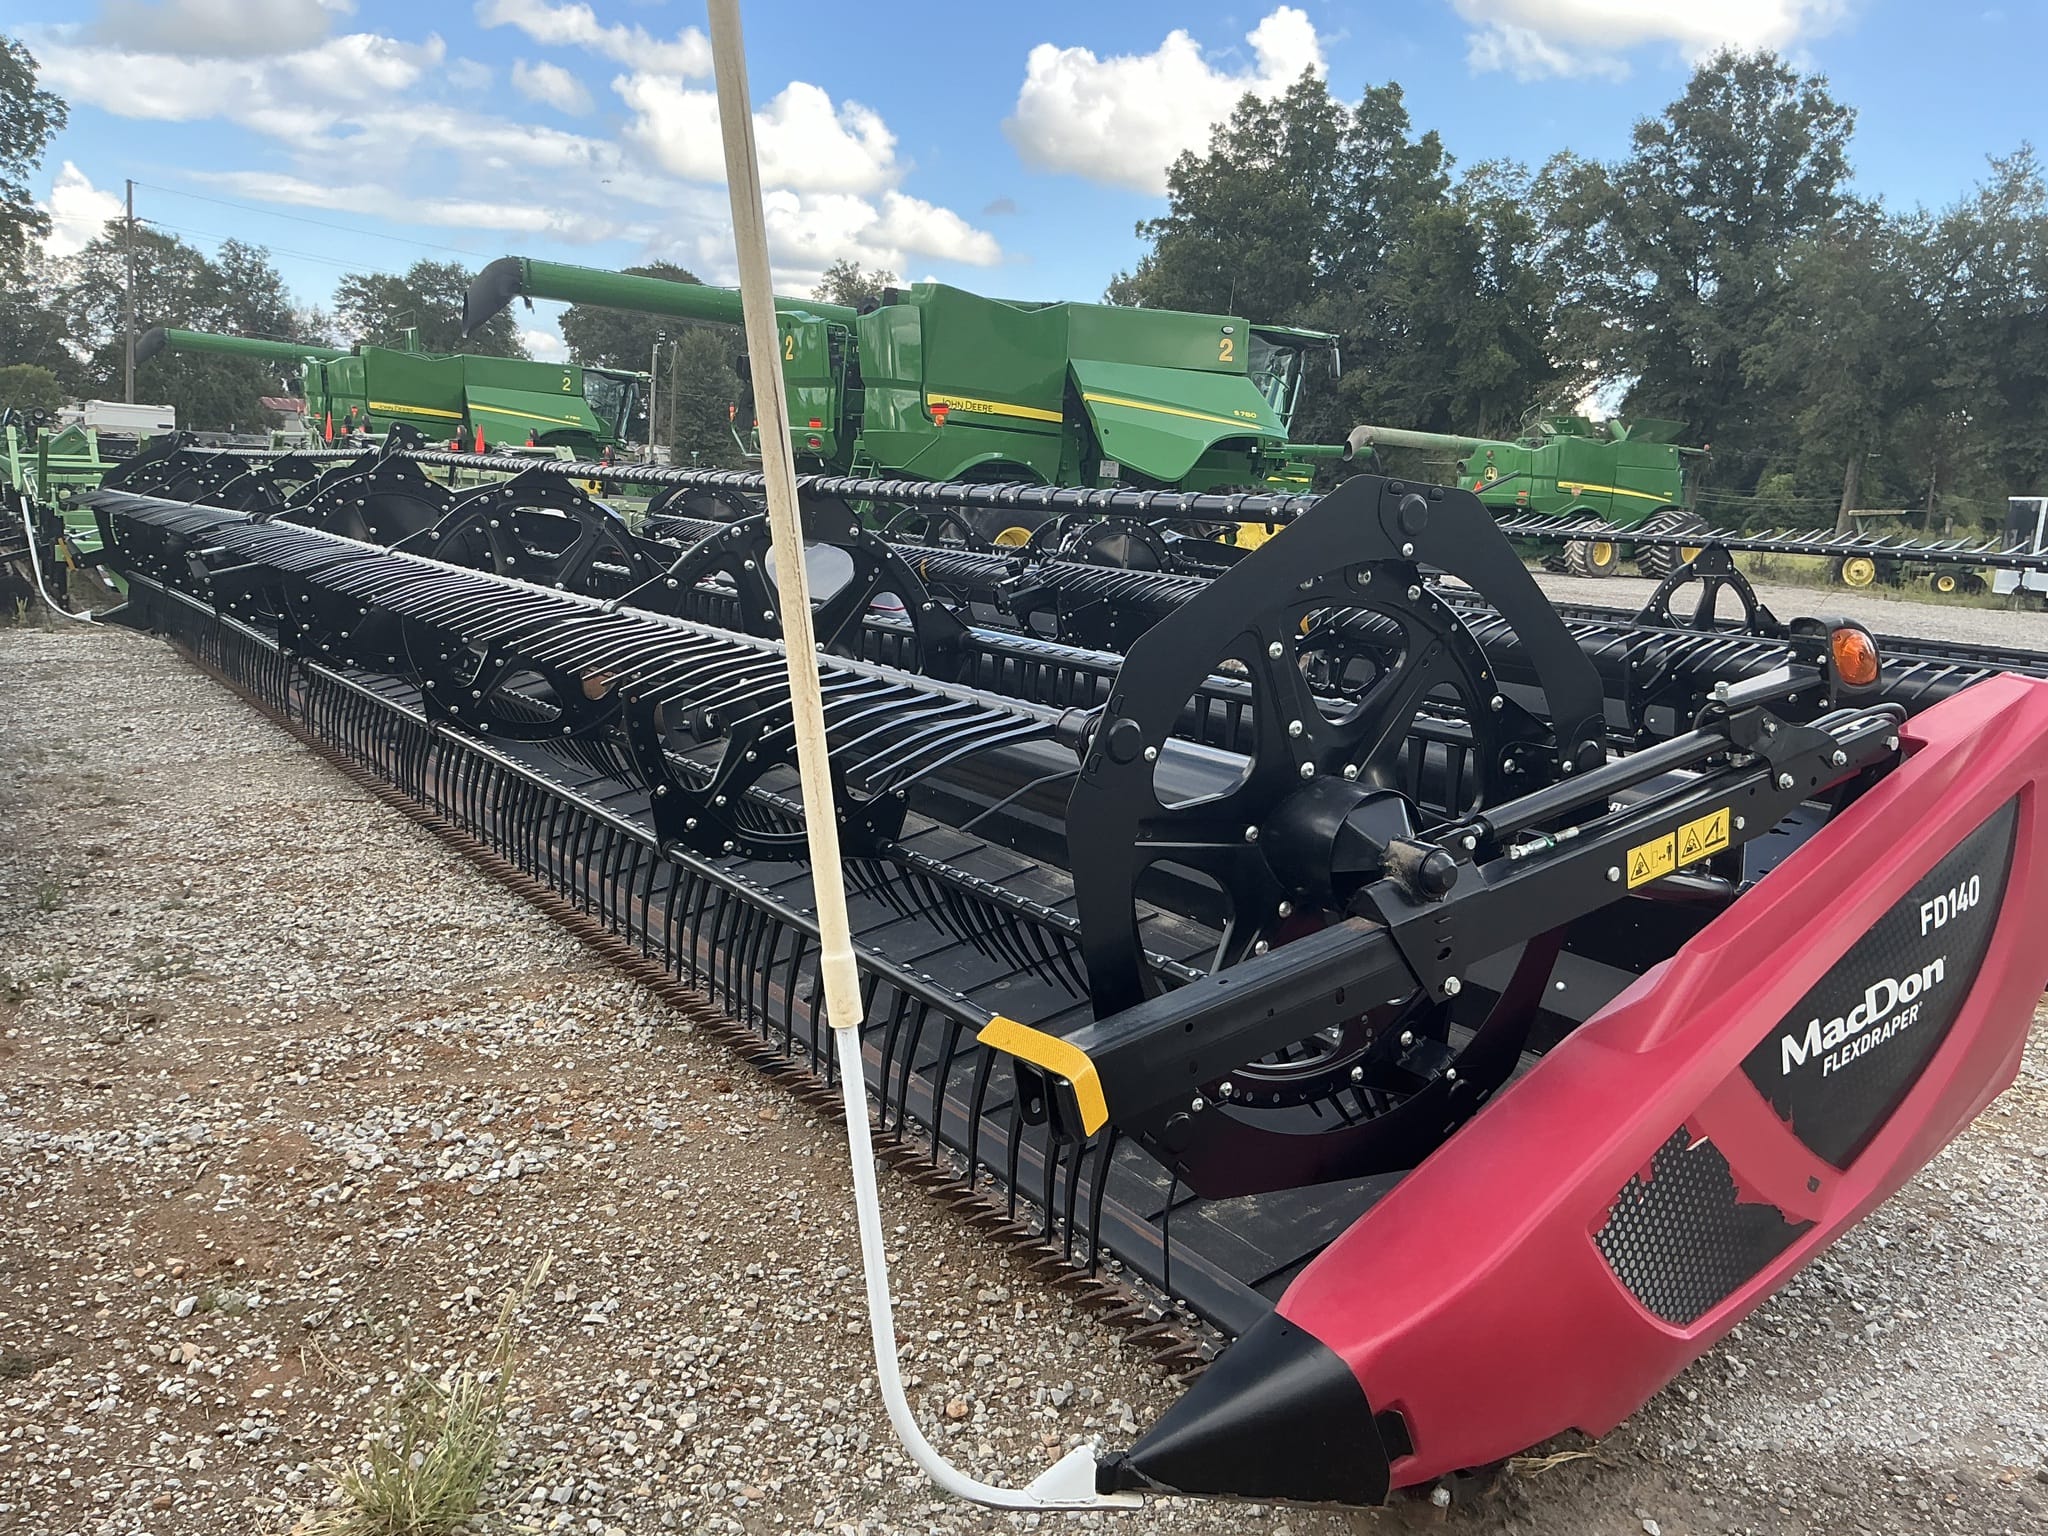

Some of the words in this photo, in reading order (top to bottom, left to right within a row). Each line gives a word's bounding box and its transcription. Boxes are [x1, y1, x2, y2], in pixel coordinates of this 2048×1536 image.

[785, 335, 794, 360] 2
[1218, 338, 1234, 362] 2
[562, 377, 571, 391] 2
[942, 397, 964, 410] JOHN
[965, 400, 994, 413] DEERE
[1920, 874, 1980, 937] FD140
[1781, 956, 1945, 1076] MacDon
[1822, 1004, 1920, 1078] FLEXDRAPER
